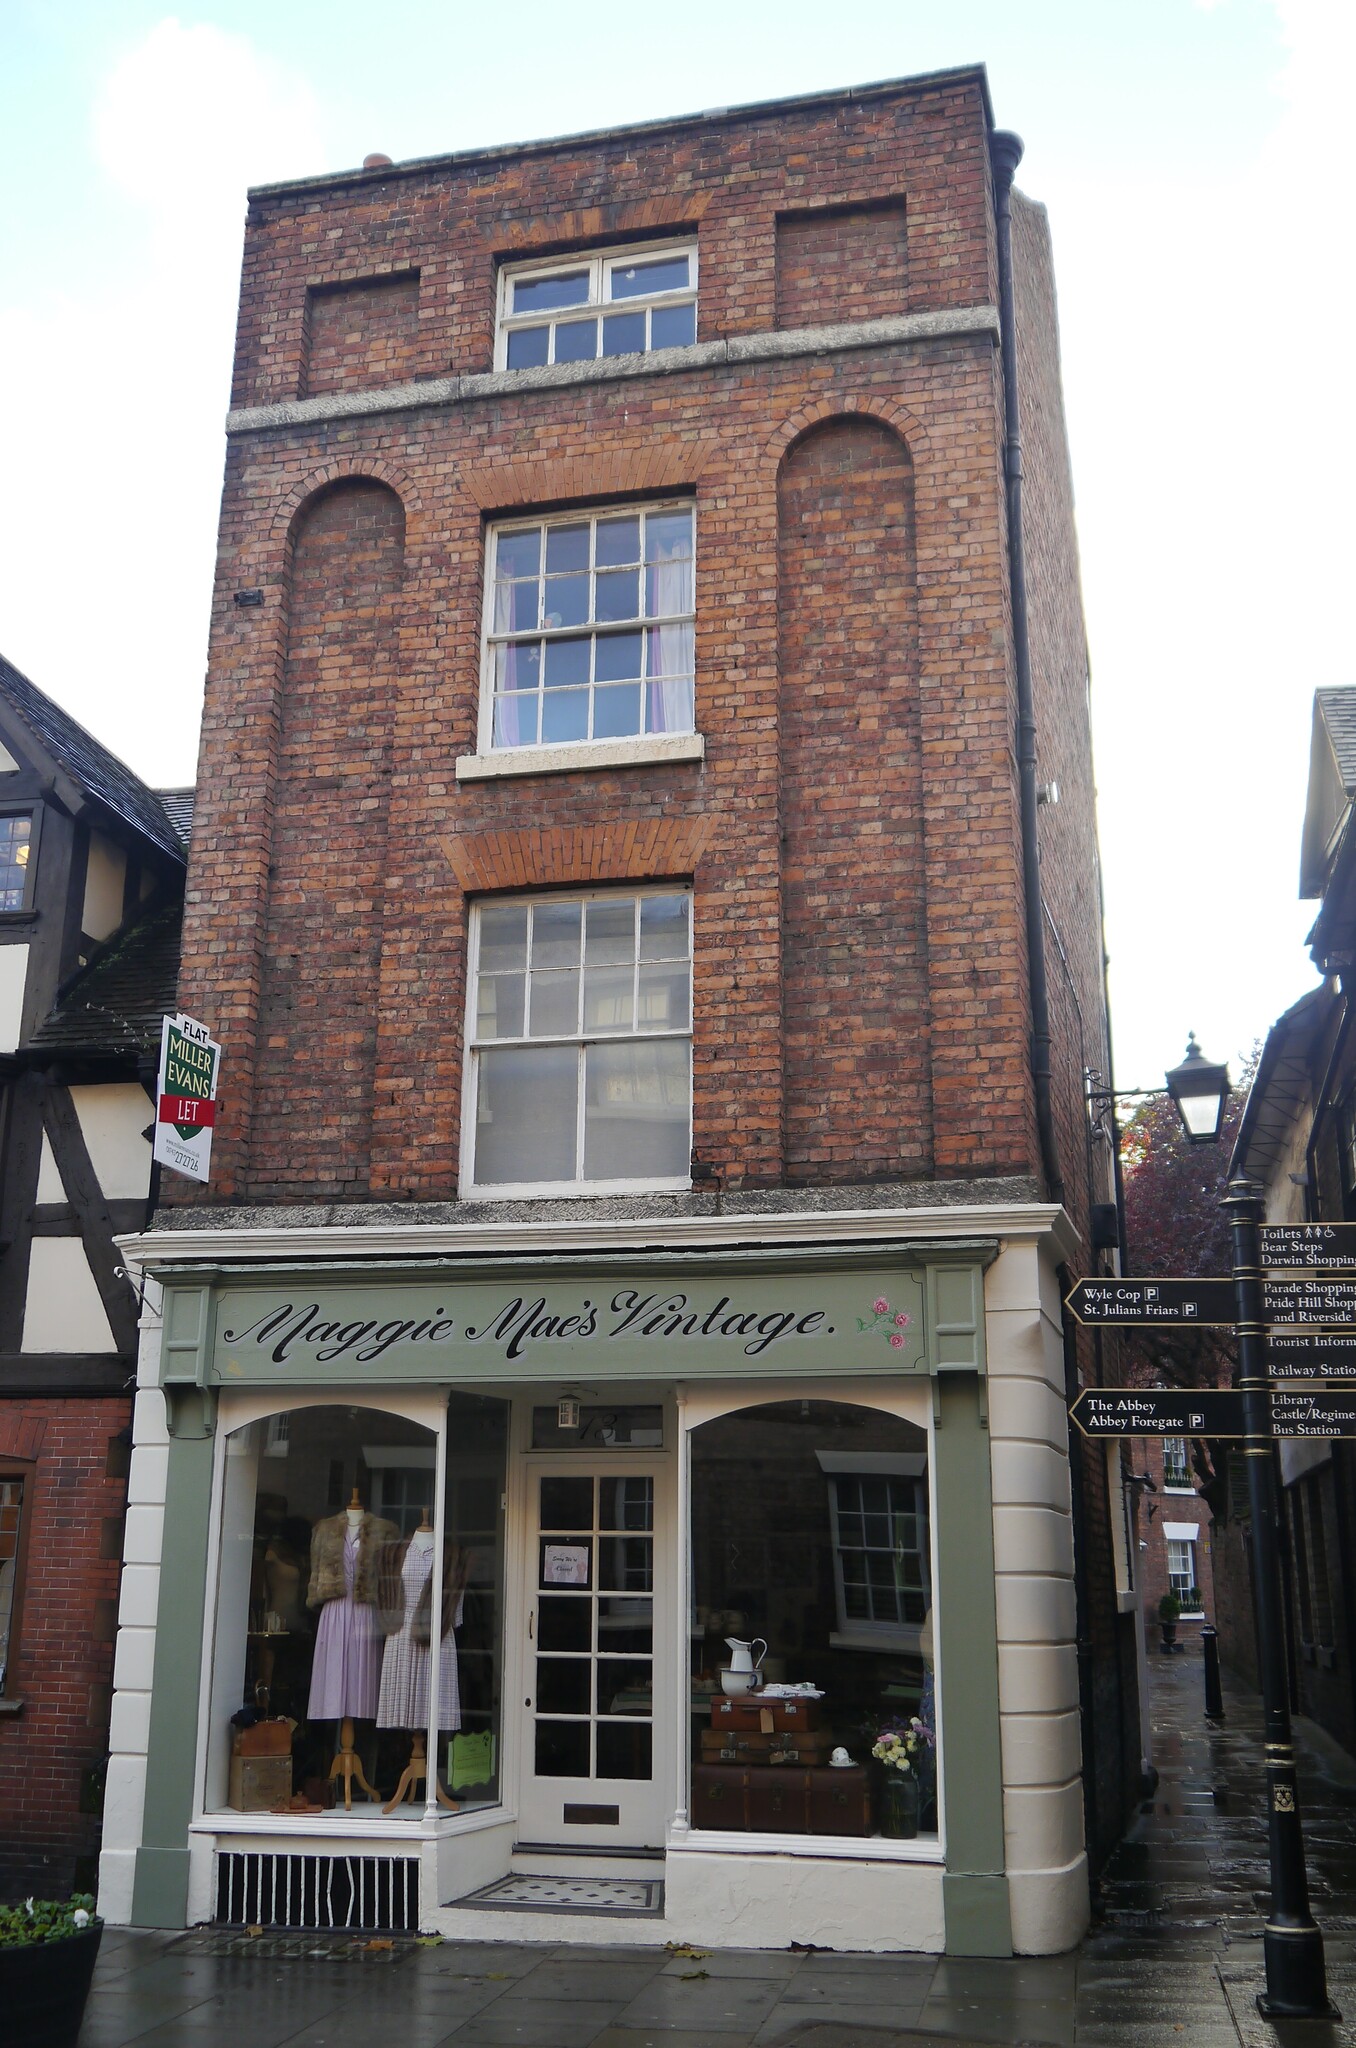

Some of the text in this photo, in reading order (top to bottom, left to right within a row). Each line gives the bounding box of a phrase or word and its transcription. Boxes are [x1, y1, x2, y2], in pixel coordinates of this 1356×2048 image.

[183, 1021, 208, 1044] FLAT
[170, 1034, 212, 1075] MILLER
[167, 1061, 210, 1099] EVANS
[178, 1100, 199, 1121] LET
[1260, 1228, 1301, 1239] Toilets
[1261, 1240, 1323, 1255] Bear Steps
[1261, 1254, 1356, 1268] Darwin Shoppin
[1084, 1288, 1113, 1302] Wyle
[1116, 1288, 1141, 1303] Cop
[1264, 1282, 1356, 1296] Parade Shoppin
[1084, 1303, 1100, 1315] St.
[1103, 1303, 1142, 1316] Julians
[1145, 1304, 1179, 1315] Friars
[1264, 1296, 1356, 1311] Pride Hill Shop
[1274, 1310, 1353, 1322] and Riverside
[224, 1290, 835, 1363] Maggie Mae's Vintage.
[1266, 1336, 1310, 1347] Tourist
[1268, 1364, 1316, 1378] Railway
[1087, 1399, 1156, 1415] The Abbey
[1271, 1393, 1316, 1408] Library
[1089, 1415, 1128, 1430] Abbey
[1131, 1415, 1184, 1430] Foregate
[1271, 1407, 1356, 1423] Castle/Regime
[1273, 1423, 1341, 1435] Bus Station
